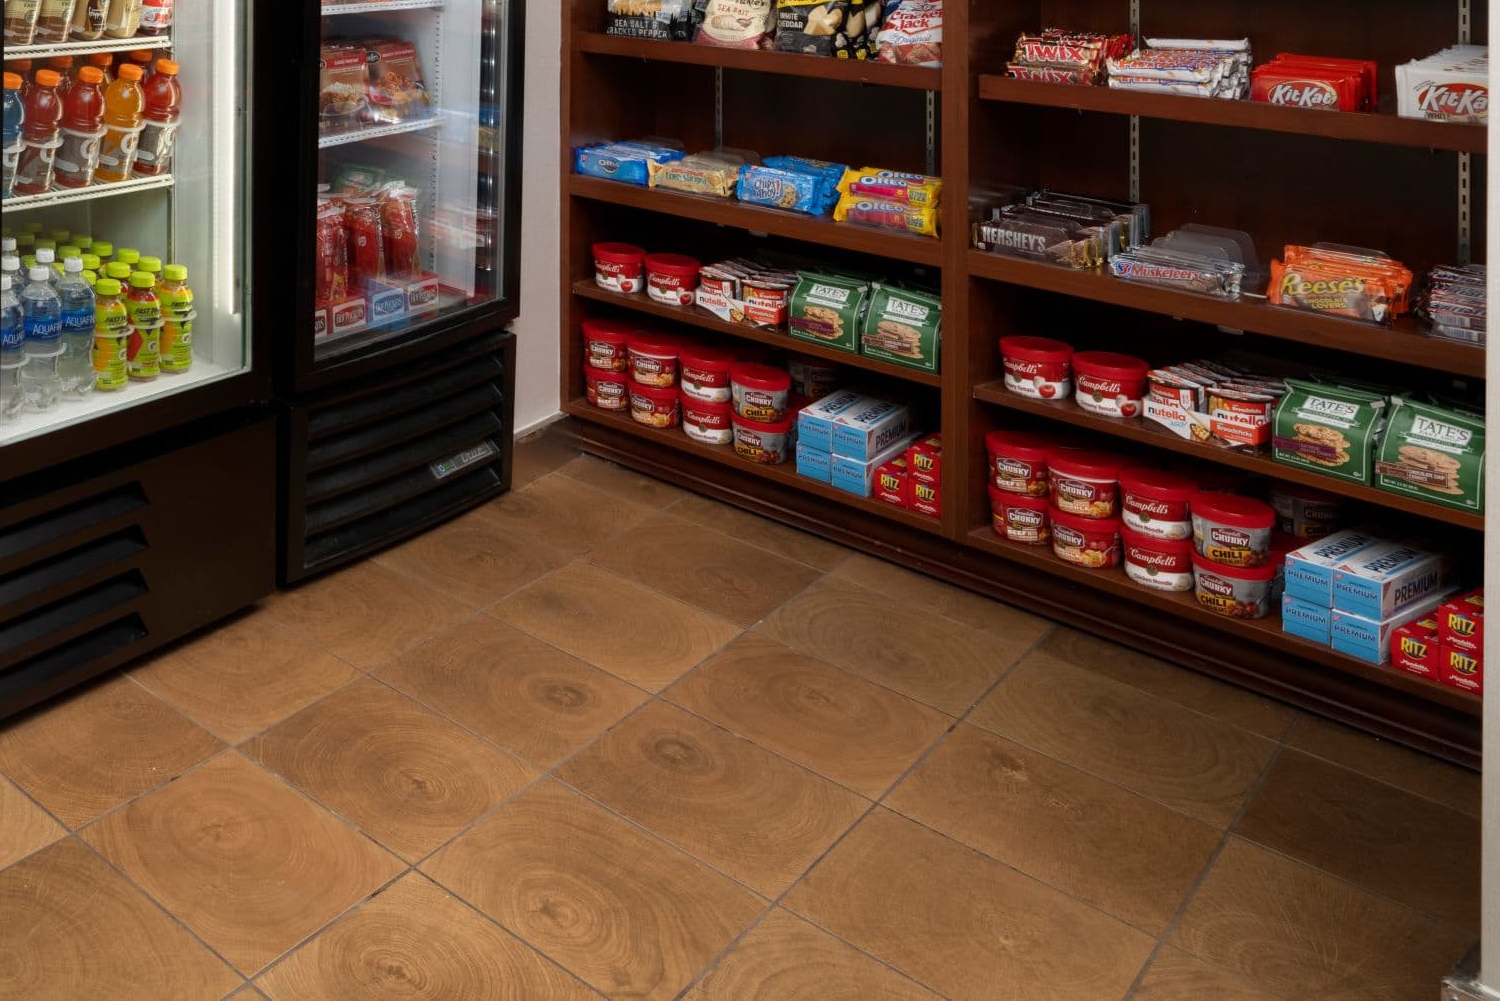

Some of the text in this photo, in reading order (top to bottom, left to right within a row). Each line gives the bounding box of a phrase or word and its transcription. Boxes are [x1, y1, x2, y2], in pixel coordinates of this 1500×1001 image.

[614, 19, 628, 27] SEA
[629, 20, 649, 29] SALT
[780, 12, 799, 20] WHITE
[895, 17, 930, 31] Jack
[638, 29, 668, 39] PEPPER
[1271, 83, 1334, 108] KitKat
[860, 175, 908, 187] OREO
[855, 200, 904, 213] OREO
[982, 226, 1046, 251] HERSHEY'S
[1131, 263, 1200, 281] Musketeers
[813, 285, 847, 298] TATE'S
[1281, 271, 1367, 296] Reese's
[890, 299, 928, 316] TATE'S
[1303, 297, 1349, 305] CHOCOLATE
[1311, 302, 1348, 310] LOVERS
[65, 316, 95, 327] AQUAFIN
[1078, 374, 1121, 393] Campbell's
[1148, 405, 1186, 422] nutella
[1309, 397, 1356, 414] TATE'S
[876, 419, 907, 448] PREMIUM
[1418, 418, 1469, 442] TATE'S
[914, 453, 934, 470] RITZ
[998, 463, 1030, 477] CHUNKY
[880, 473, 900, 490] RITZ
[915, 484, 936, 500] RITZ
[1059, 483, 1094, 498] CHUNKY
[1125, 494, 1169, 515] Campbell's
[1009, 512, 1042, 525] CHUNKY
[1211, 531, 1250, 546] CHUNKY
[1314, 535, 1367, 559] PREMIUM
[1131, 547, 1177, 567] Campbell's
[1211, 550, 1243, 559] CHILI
[1364, 548, 1417, 574] PREMIUM
[1199, 577, 1233, 594] CHUNKY
[1287, 570, 1329, 587] PREMIUM
[1336, 583, 1378, 601] PREMIUM
[1394, 572, 1439, 606] PREMIUM
[1200, 595, 1228, 608] CHILI
[1285, 607, 1326, 625] PREMIUM
[1448, 613, 1476, 636] RITZ
[1333, 624, 1376, 642] PREMIUM
[1401, 636, 1428, 659] RITZ
[1450, 652, 1478, 674] RITZ
